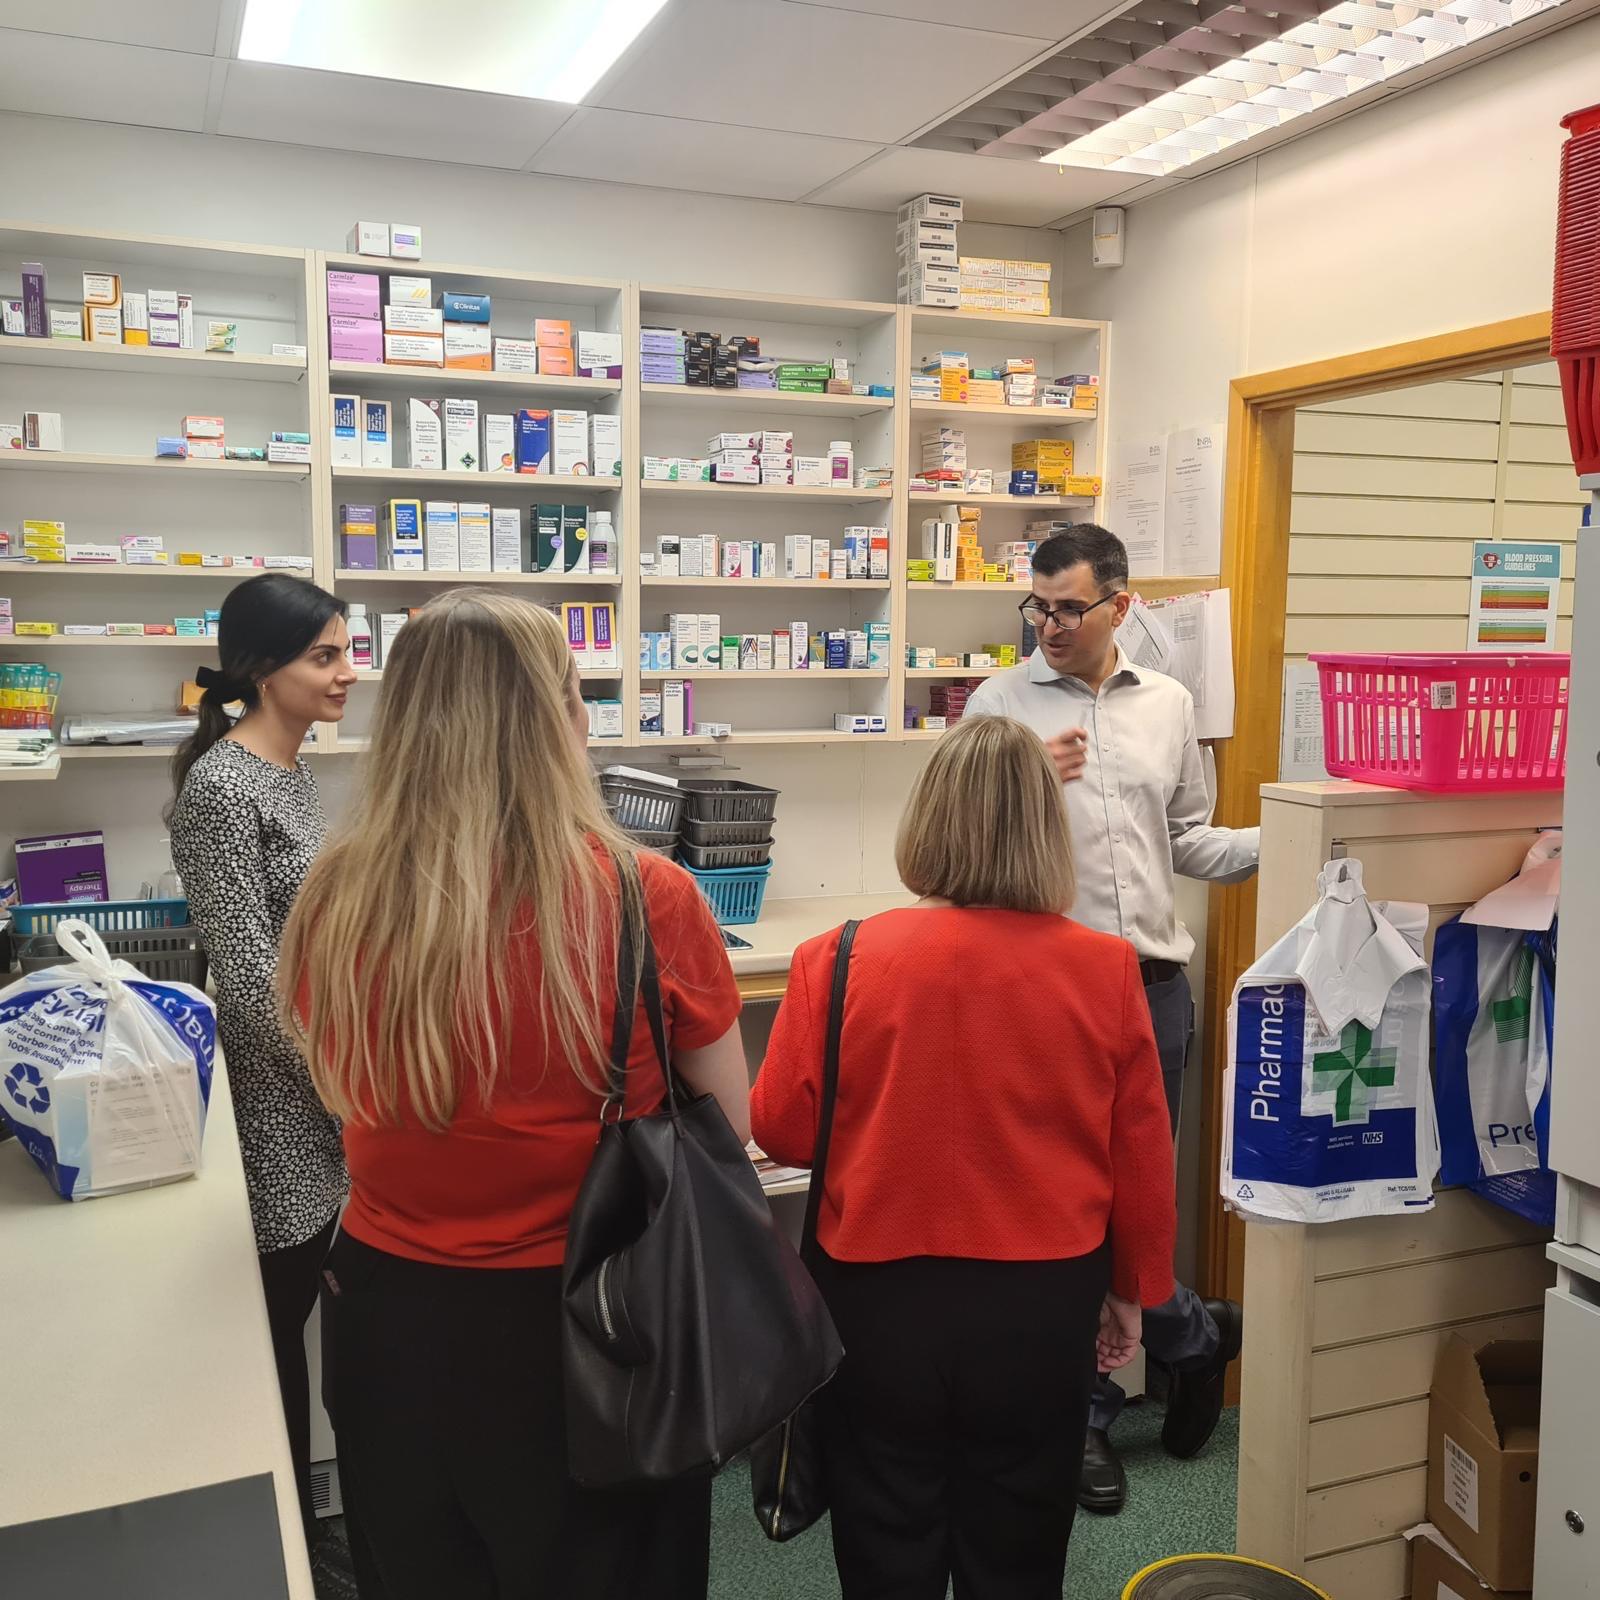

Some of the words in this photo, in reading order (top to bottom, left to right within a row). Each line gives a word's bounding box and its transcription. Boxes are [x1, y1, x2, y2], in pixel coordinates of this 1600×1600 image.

[1504, 554, 1524, 562] BLOOD
[1525, 554, 1553, 563] PRESSURE
[1504, 563, 1536, 571] GUIDELINES
[70, 884, 101, 892] Therapy
[17, 1032, 48, 1050] carbon
[8, 1039, 31, 1055] 100%
[1363, 1132, 1382, 1143] NHS
